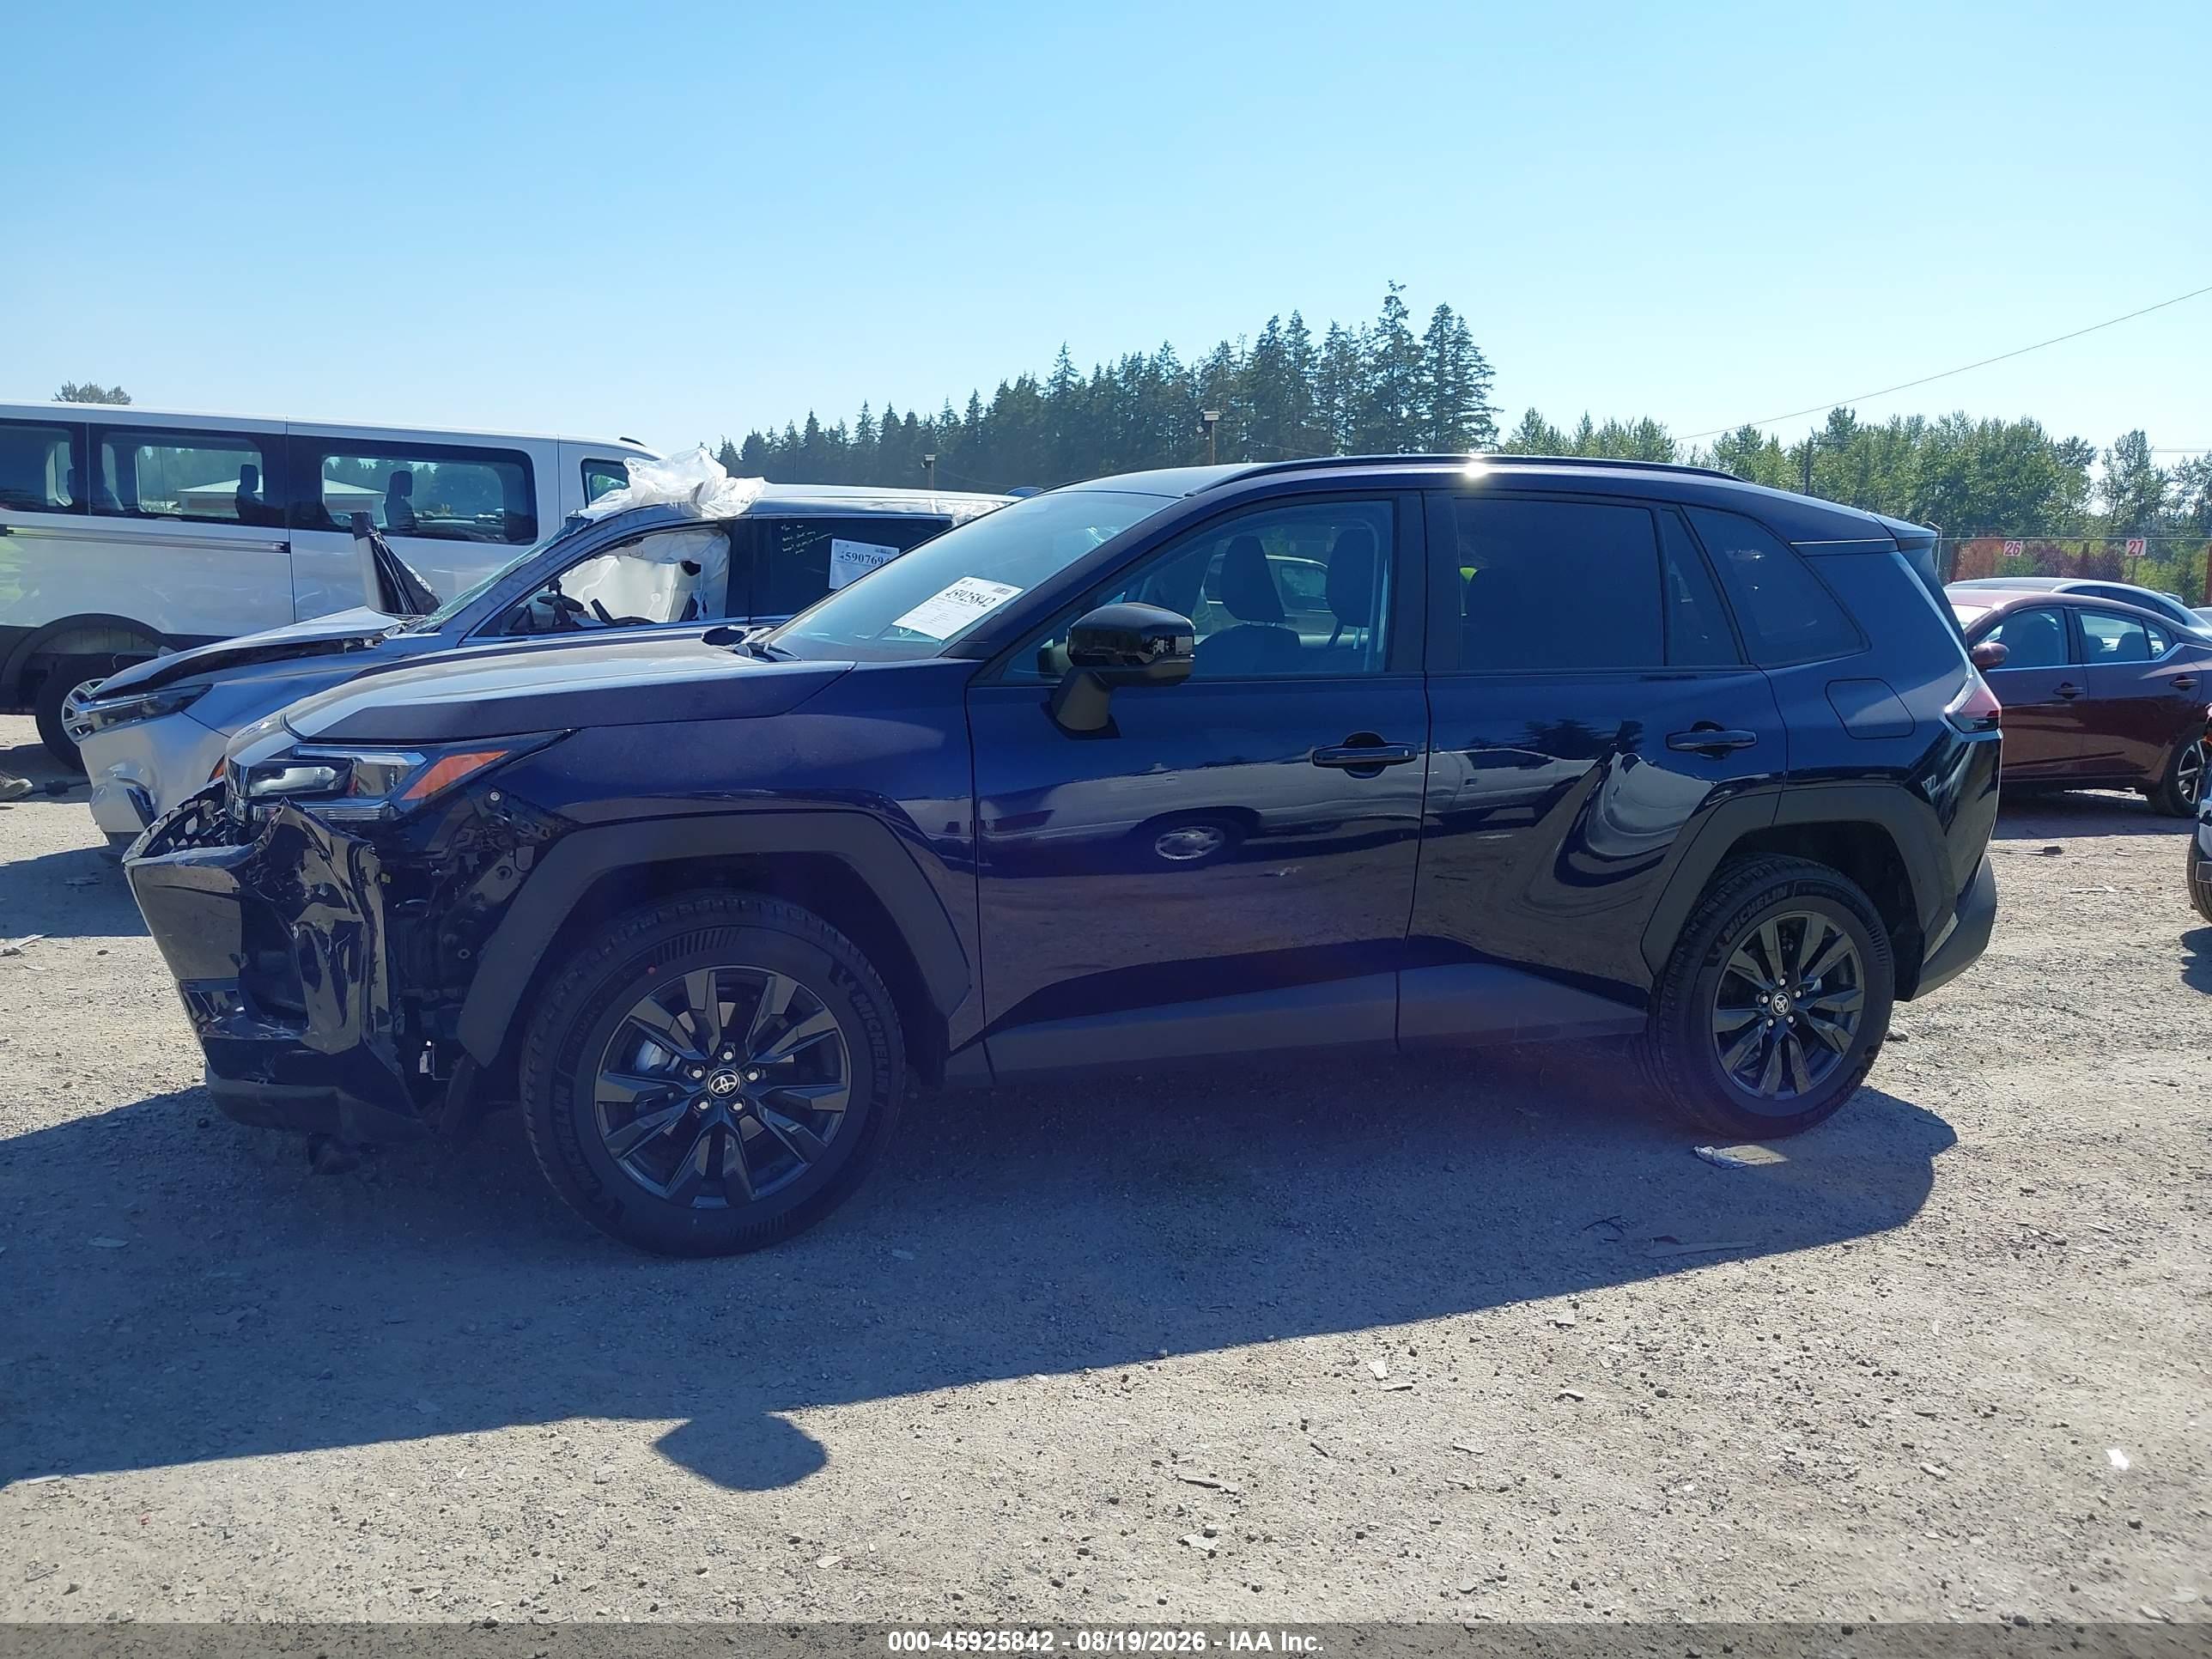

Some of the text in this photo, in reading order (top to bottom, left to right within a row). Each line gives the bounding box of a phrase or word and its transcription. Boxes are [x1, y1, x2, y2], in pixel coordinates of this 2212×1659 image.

[2004, 541, 2021, 556] 26
[2128, 540, 2145, 556] 27
[944, 587, 998, 608] 45925842
[1723, 884, 1789, 943] MICHELIN
[852, 990, 890, 1094] MICHELIN
